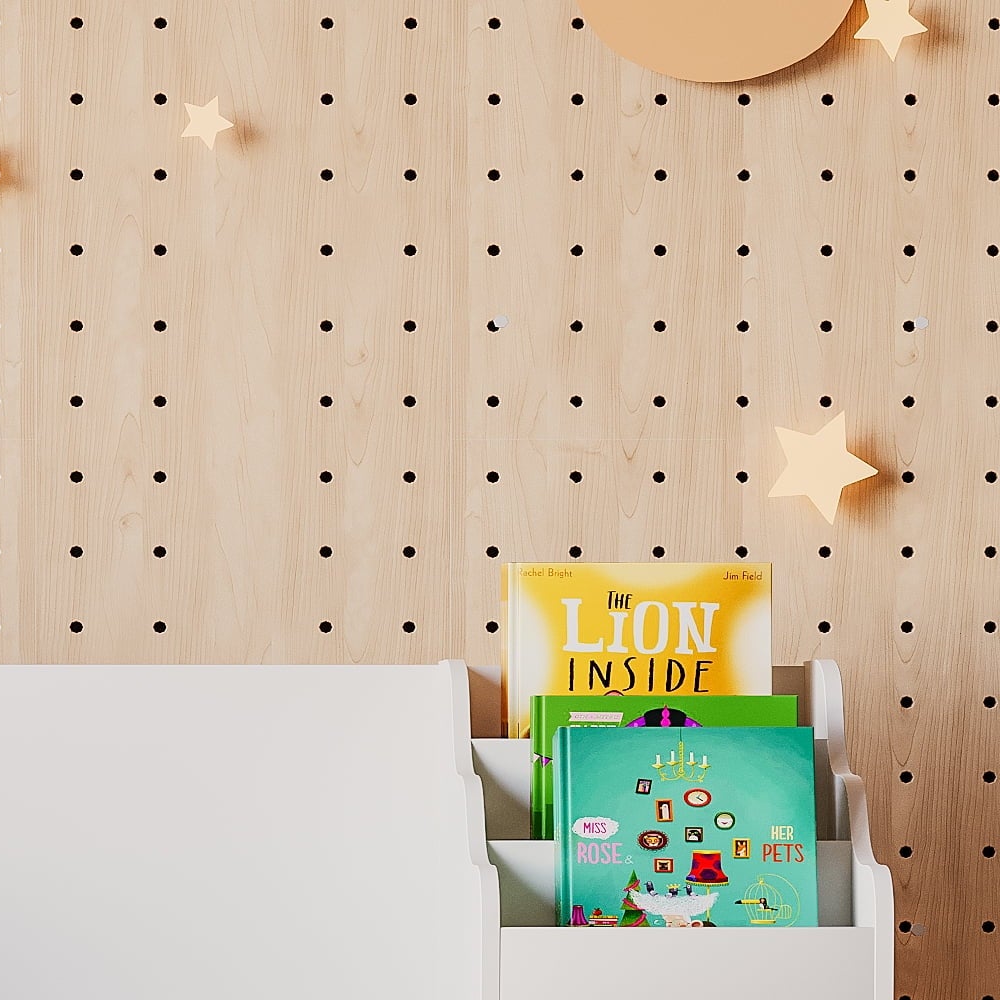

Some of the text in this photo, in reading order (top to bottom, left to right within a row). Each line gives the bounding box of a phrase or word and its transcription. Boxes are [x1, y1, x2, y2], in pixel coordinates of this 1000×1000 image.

[548, 568, 573, 579] Bright
[722, 570, 763, 581] Jim Field
[607, 590, 633, 610] THE
[568, 656, 713, 693] INSIDE
[583, 822, 607, 834] MISS
[771, 826, 794, 841] HER
[577, 842, 624, 864] ROSE
[762, 843, 805, 863] PETS
